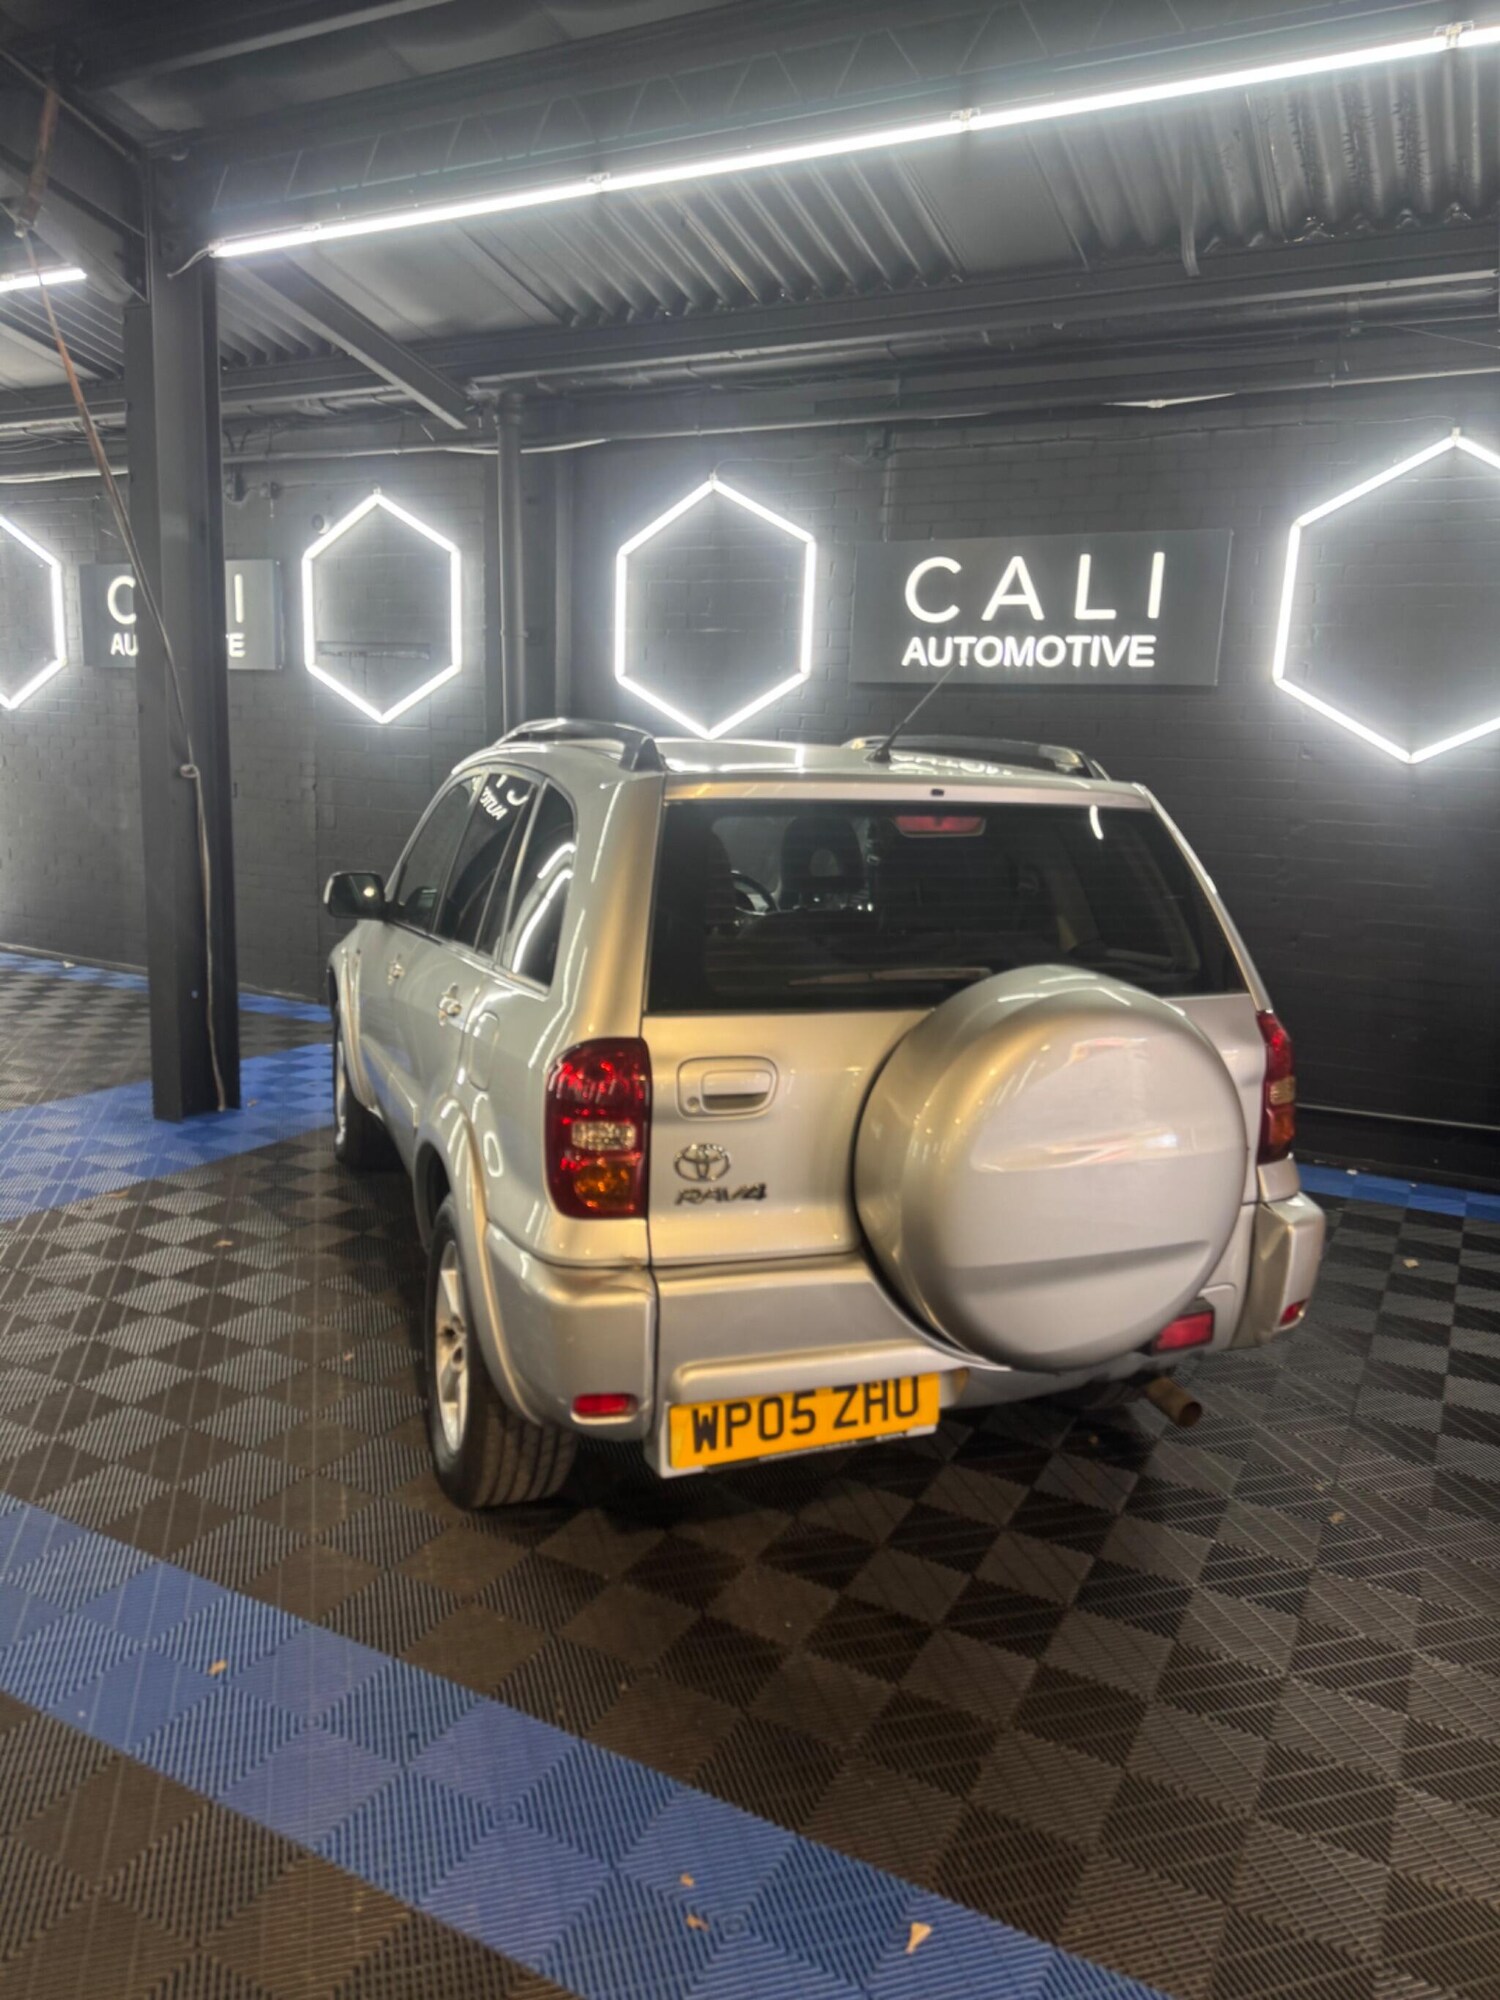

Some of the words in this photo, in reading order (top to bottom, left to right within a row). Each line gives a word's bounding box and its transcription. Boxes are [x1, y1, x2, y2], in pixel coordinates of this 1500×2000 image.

[904, 551, 1165, 623] CALI
[901, 634, 1157, 668] AUTOMOTIVE
[674, 1183, 767, 1206] RAV4
[692, 1388, 817, 1454] WP05
[831, 1376, 919, 1430] ZHU
